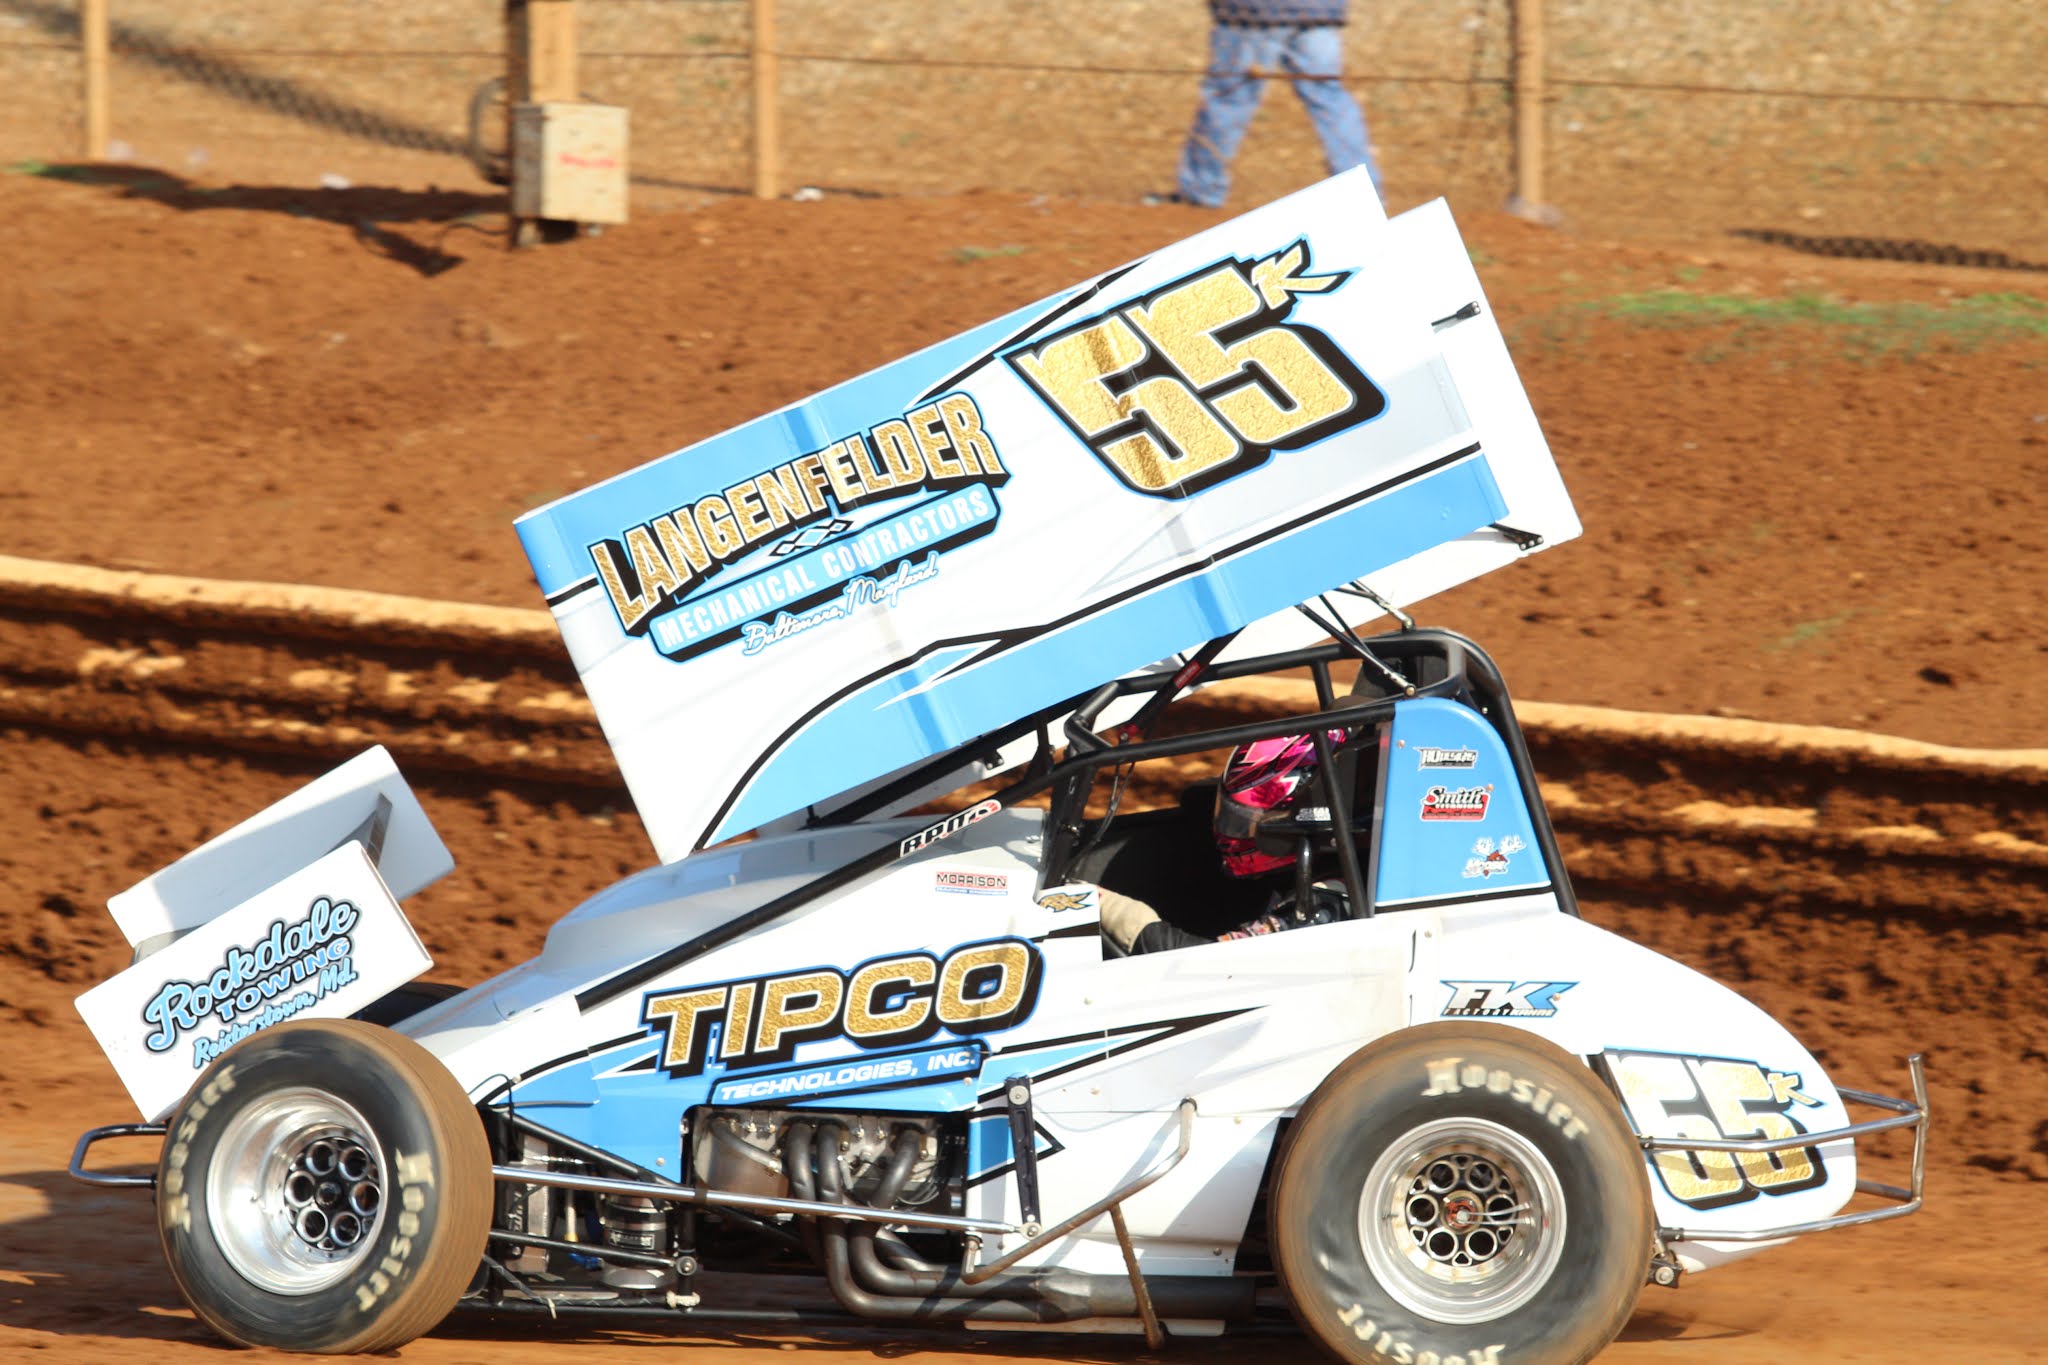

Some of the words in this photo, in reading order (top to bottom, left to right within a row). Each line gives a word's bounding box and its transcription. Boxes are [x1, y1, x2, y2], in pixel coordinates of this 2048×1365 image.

[590, 393, 1005, 633] LANGENFELDER
[655, 564, 817, 649] MECHANICAL
[822, 489, 989, 580] CONTRACTORS
[743, 612, 845, 655] Baltimore,
[846, 553, 938, 613] Maryland
[1422, 787, 1484, 805] Smith
[937, 874, 1006, 887] MORRISON
[144, 898, 359, 1051] Rockdale
[216, 936, 352, 1022] TOWING
[318, 957, 358, 998] Md.
[645, 941, 1037, 1072] TIPCO
[720, 1060, 919, 1100] TECHNOLOGIES,
[927, 1051, 976, 1072] INC.
[1421, 1057, 1590, 1139] Hoosier
